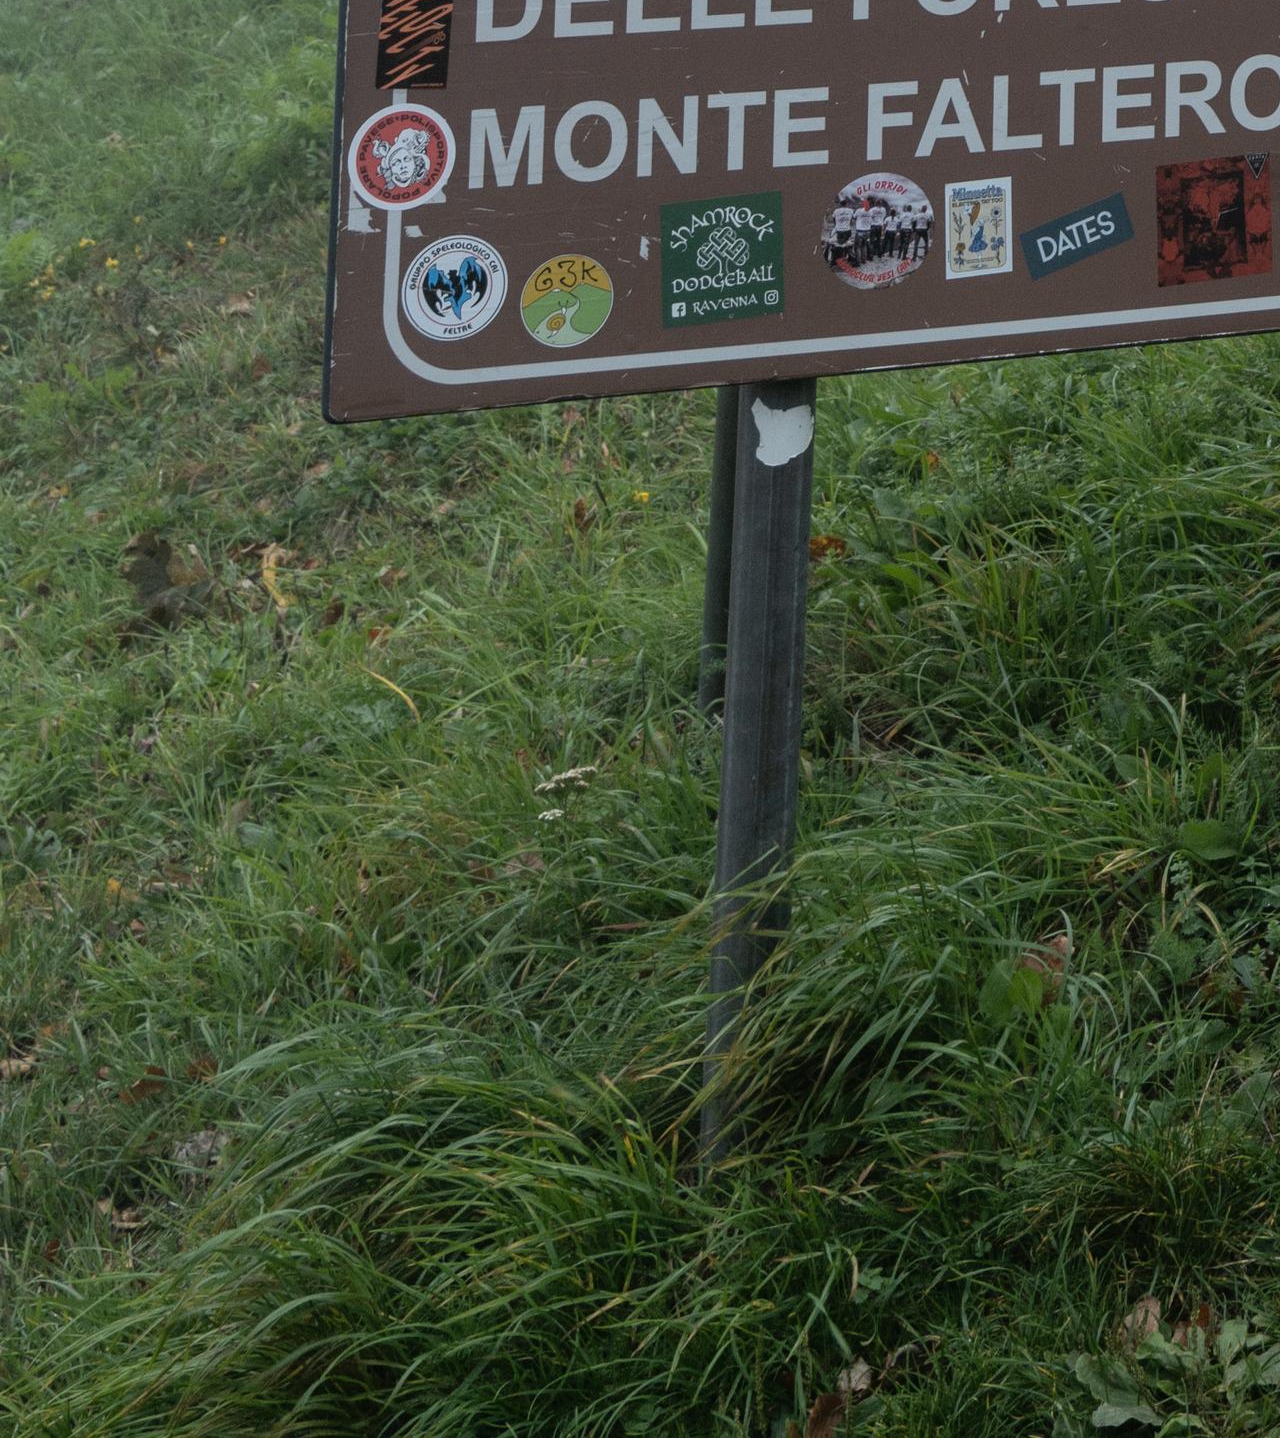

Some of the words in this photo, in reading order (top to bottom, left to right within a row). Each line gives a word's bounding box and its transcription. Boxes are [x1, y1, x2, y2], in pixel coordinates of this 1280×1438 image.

[469, 86, 830, 189] MONTE
[856, 181, 872, 197] GLI
[874, 179, 909, 196] ORRIDI
[669, 204, 777, 253] SHAMROCK
[1036, 209, 1117, 265] DATES
[671, 266, 777, 295] DODGEBALL
[692, 293, 759, 316] RAVENNA
[443, 322, 474, 337] FELTRE
